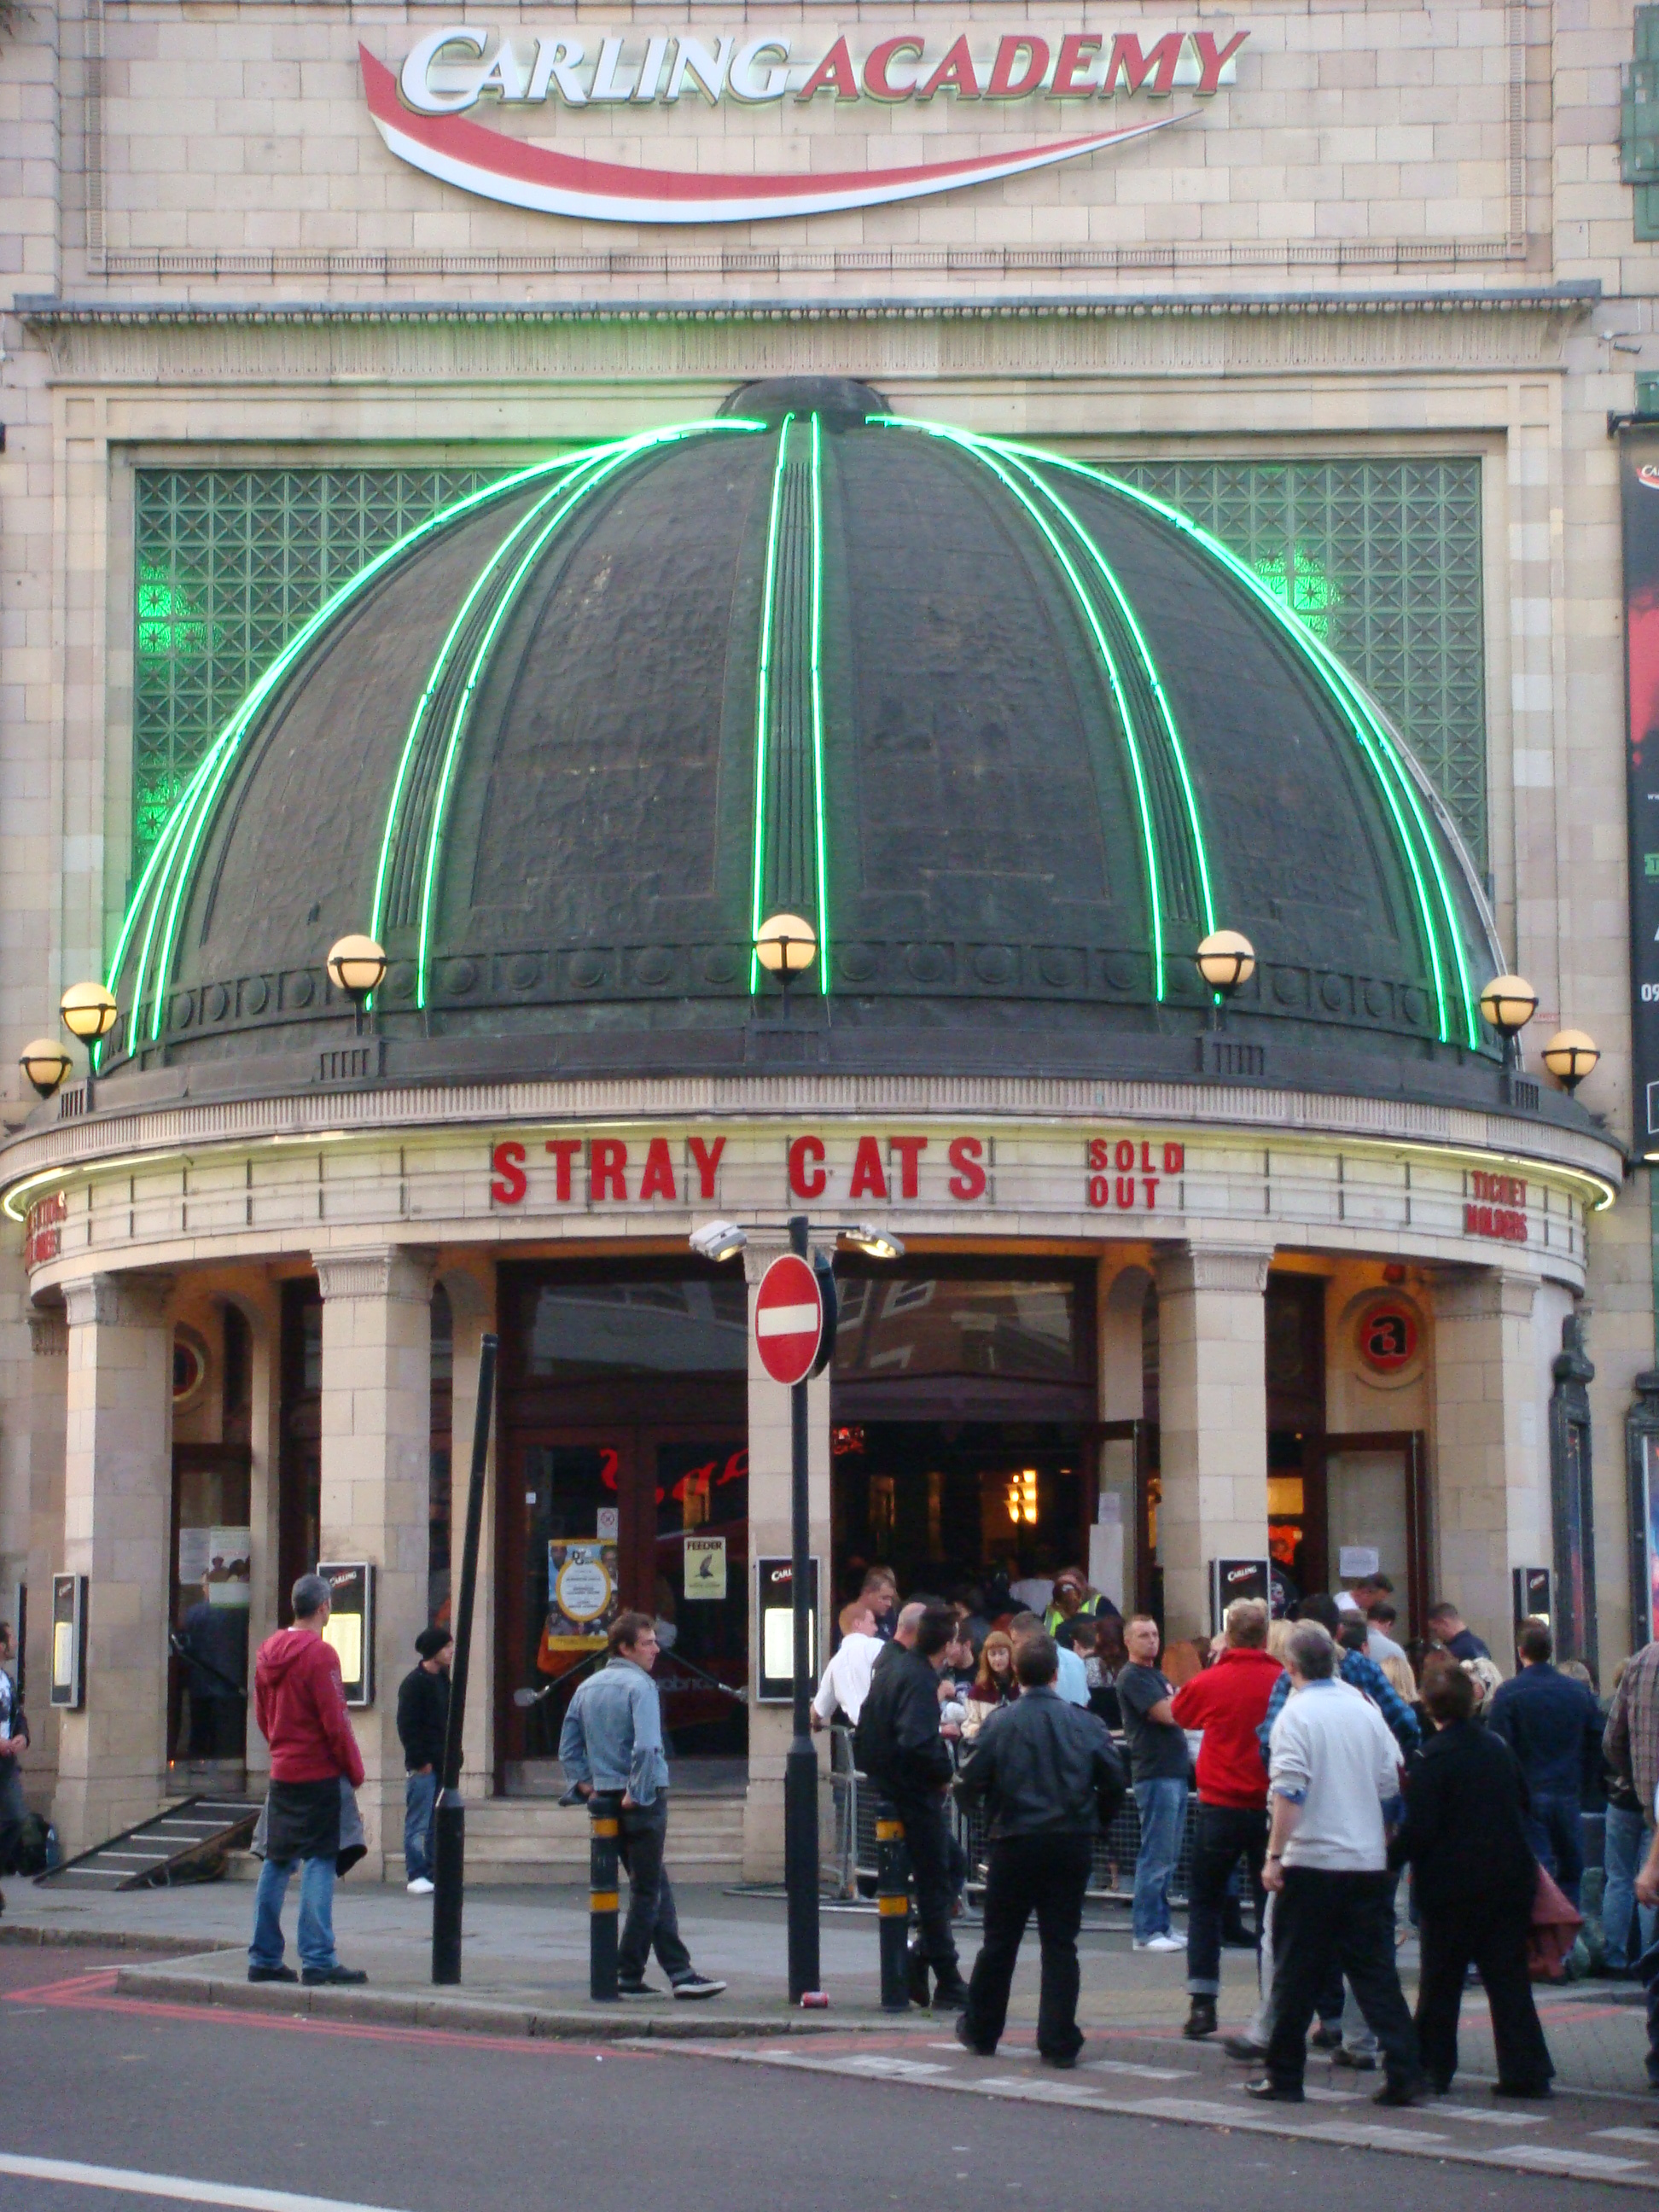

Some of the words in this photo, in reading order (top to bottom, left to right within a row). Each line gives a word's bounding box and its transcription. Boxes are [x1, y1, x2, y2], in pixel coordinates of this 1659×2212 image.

[399, 28, 791, 115] CARLING
[795, 32, 1251, 103] ACADEMY
[1642, 464, 1659, 477] CA
[492, 1137, 726, 1204] STRAY
[789, 1135, 986, 1201] CATS
[1090, 1138, 1184, 1174] SOLD
[1089, 1176, 1160, 1209] OUT
[1470, 1170, 1528, 1208] TICKET
[687, 1540, 723, 1551] FEEDER
